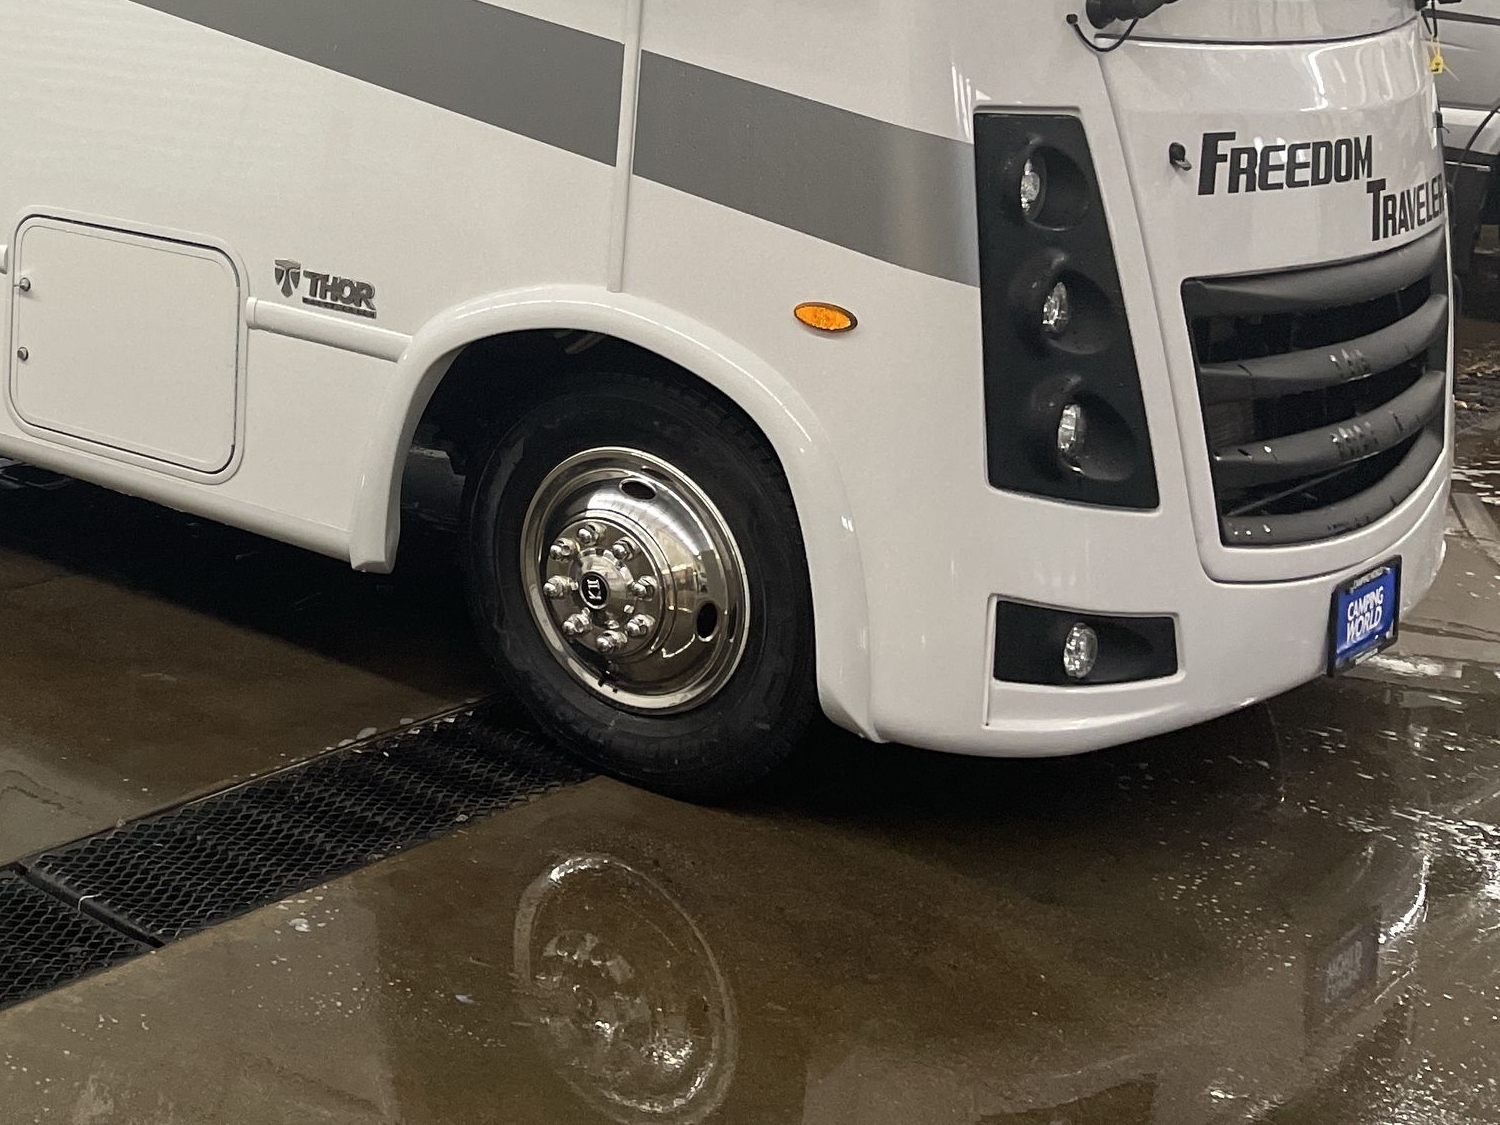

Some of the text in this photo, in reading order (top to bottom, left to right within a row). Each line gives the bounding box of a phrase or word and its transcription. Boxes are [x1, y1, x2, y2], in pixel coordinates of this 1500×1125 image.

[1197, 131, 1373, 196] FREEDOM
[303, 270, 376, 310] THOR
[1347, 585, 1384, 621] CAMPING
[1347, 606, 1382, 644] WORLD
